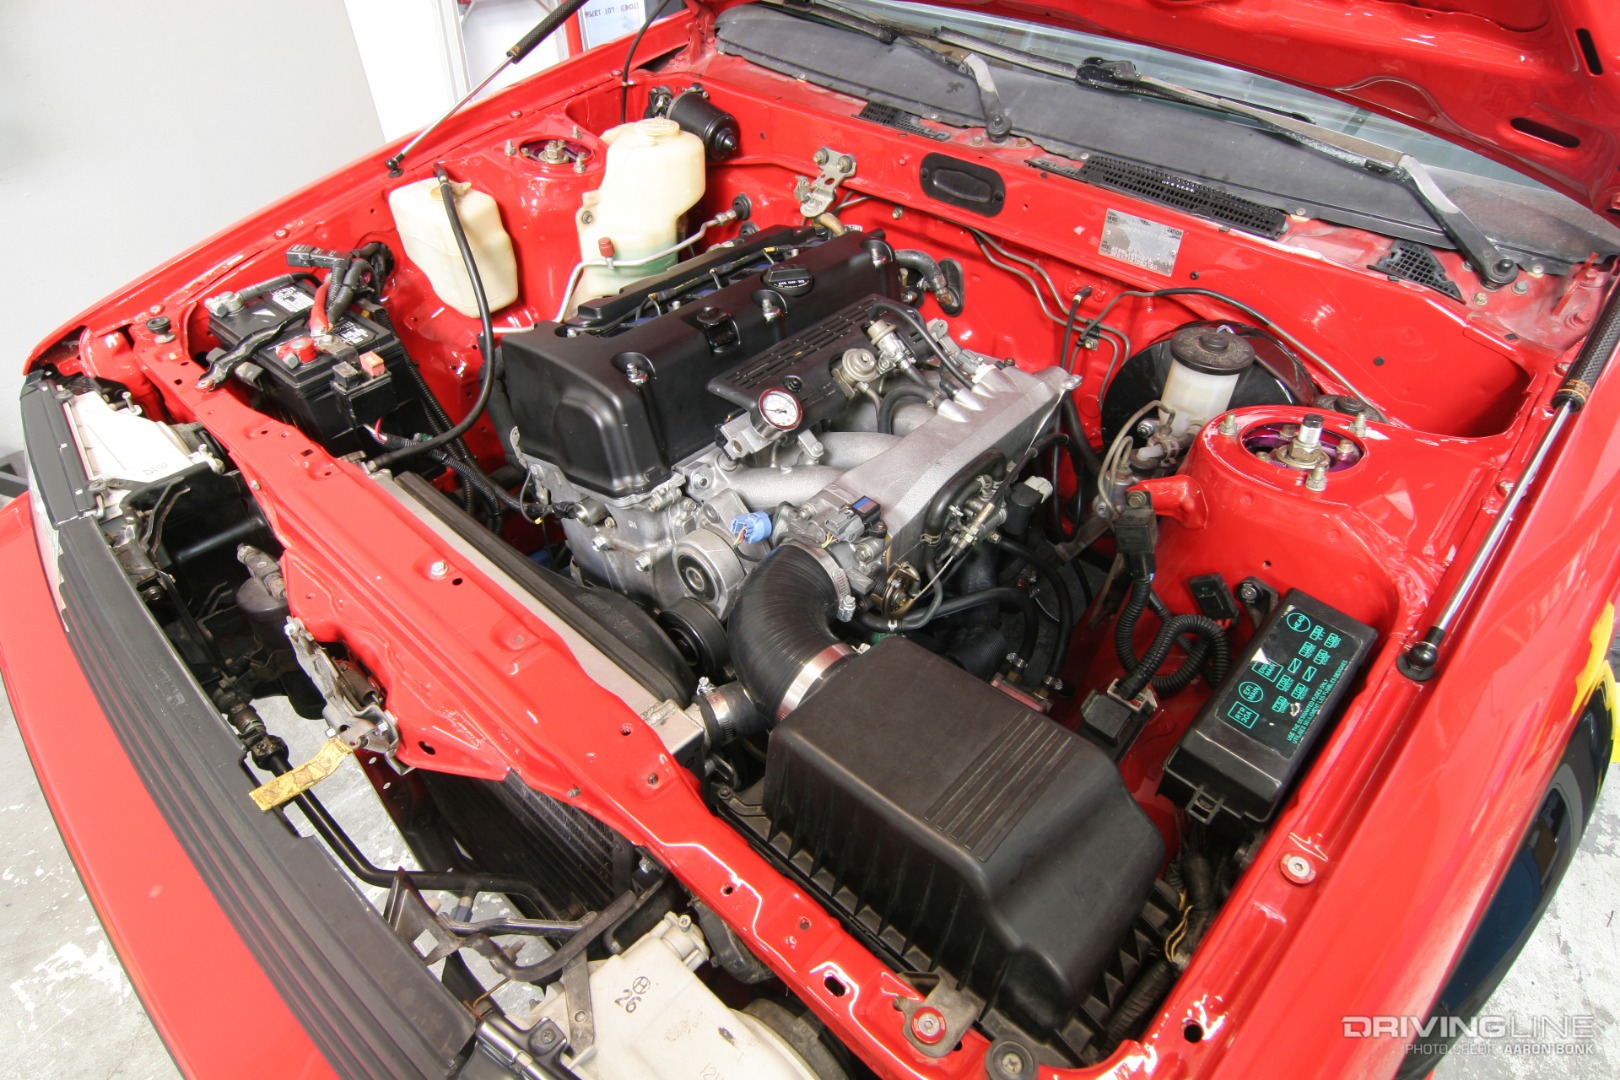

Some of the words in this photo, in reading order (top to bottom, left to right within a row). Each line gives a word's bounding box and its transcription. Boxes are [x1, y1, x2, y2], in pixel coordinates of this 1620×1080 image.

[1294, 615, 1305, 629] HEAD
[1243, 685, 1253, 695] EFI
[1248, 686, 1260, 701] MAIN
[1235, 707, 1246, 719] RTR
[1241, 710, 1252, 723] 30A
[614, 988, 642, 1014] 26
